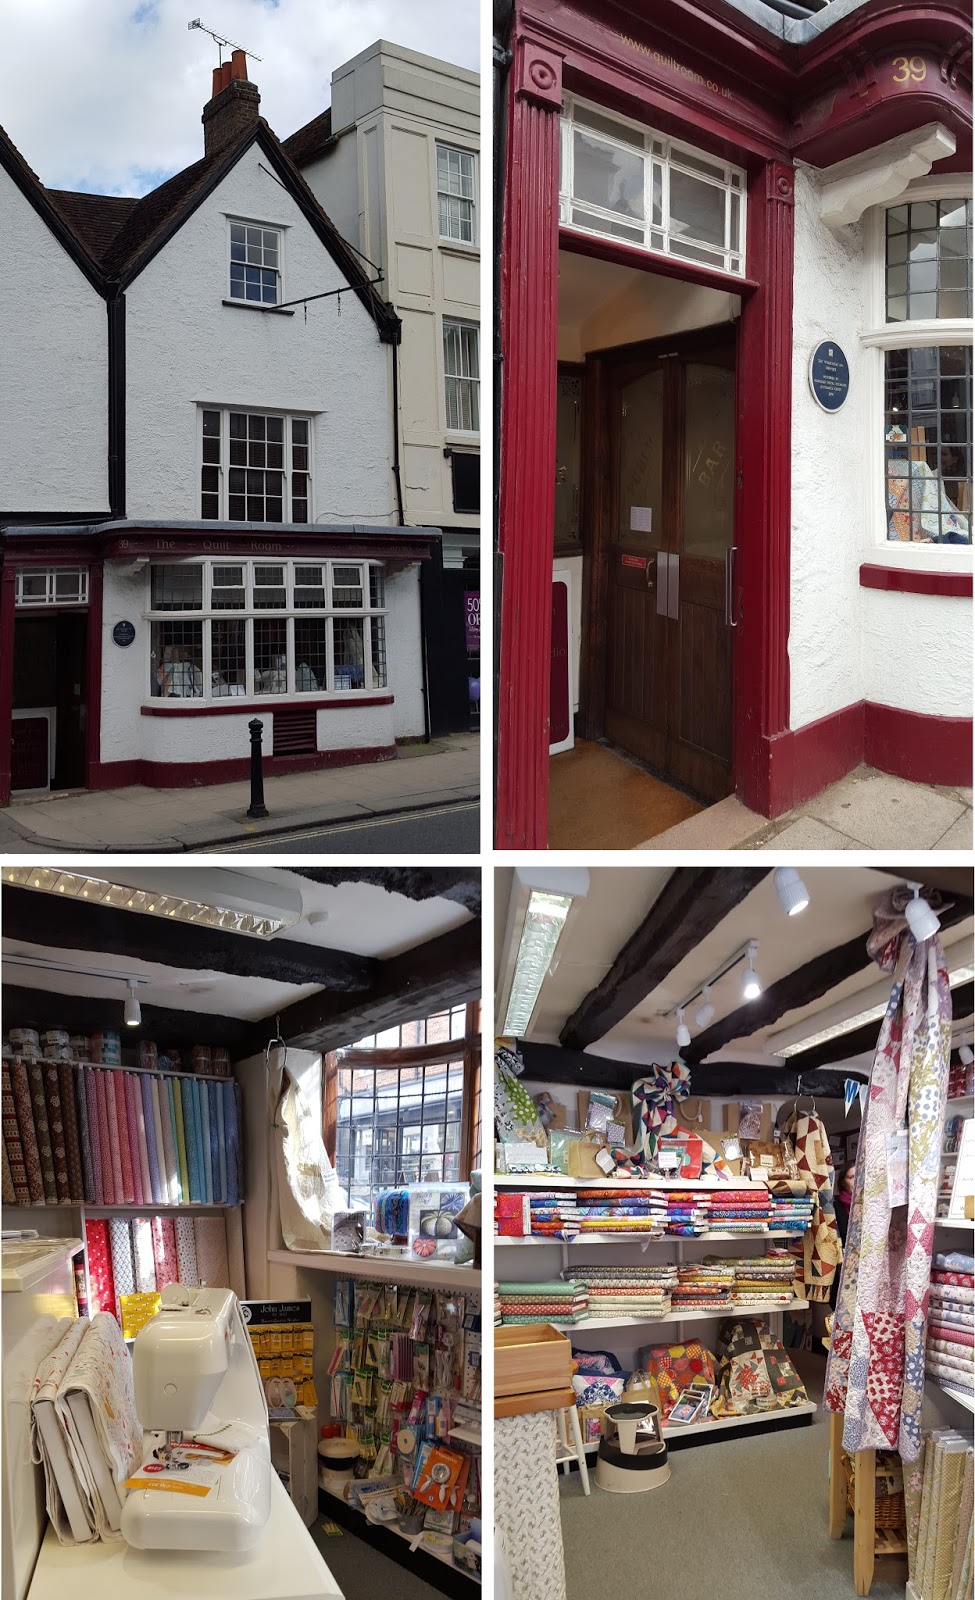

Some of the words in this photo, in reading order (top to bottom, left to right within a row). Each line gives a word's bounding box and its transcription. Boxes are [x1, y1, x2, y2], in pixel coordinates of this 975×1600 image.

[620, 33, 733, 101] www.quiltroom.co.uk
[892, 56, 927, 82] 39
[698, 440, 726, 488] BAR
[118, 539, 129, 549] 39
[155, 538, 176, 549] The
[203, 538, 230, 550] Quilt
[251, 540, 282, 551] Room
[466, 597, 480, 612] 50
[260, 1304, 277, 1313] John
[279, 1303, 301, 1312] James
